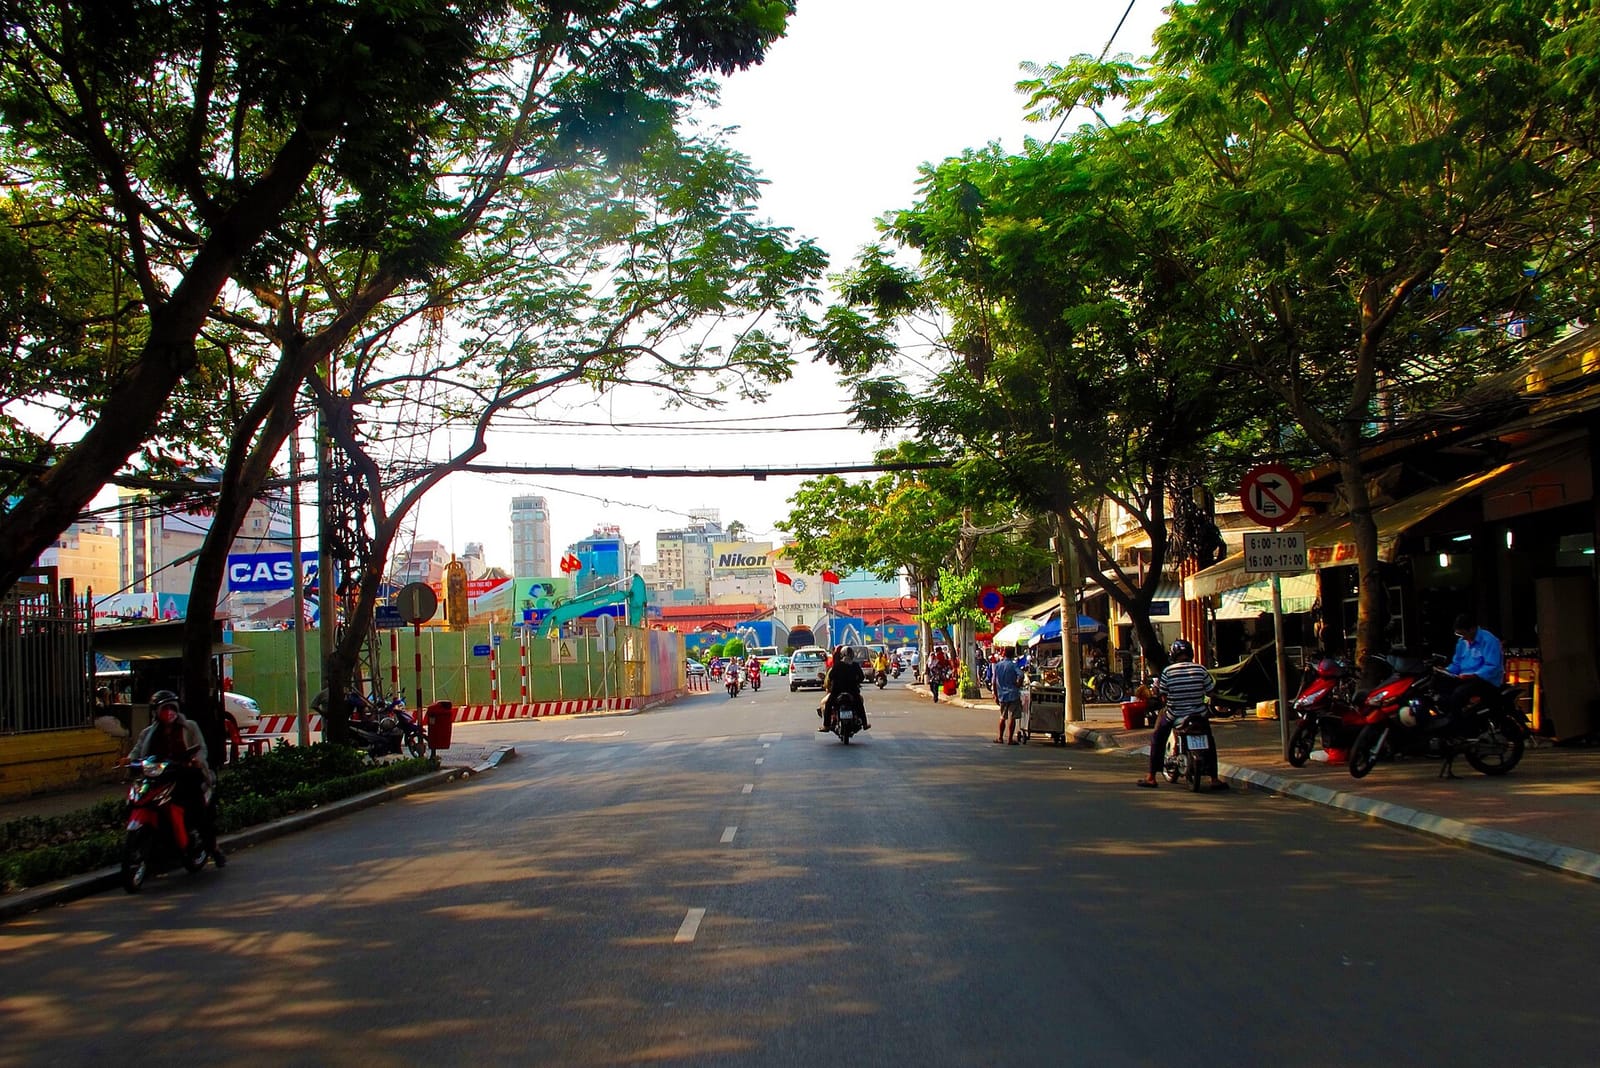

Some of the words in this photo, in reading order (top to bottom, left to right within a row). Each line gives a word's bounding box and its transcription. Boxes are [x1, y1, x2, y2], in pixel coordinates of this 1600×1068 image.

[1251, 537, 1297, 549] 6:00-7:00
[719, 554, 767, 567] Nikon
[1249, 554, 1303, 567] 16:00-17:00
[230, 560, 320, 582] CASO
